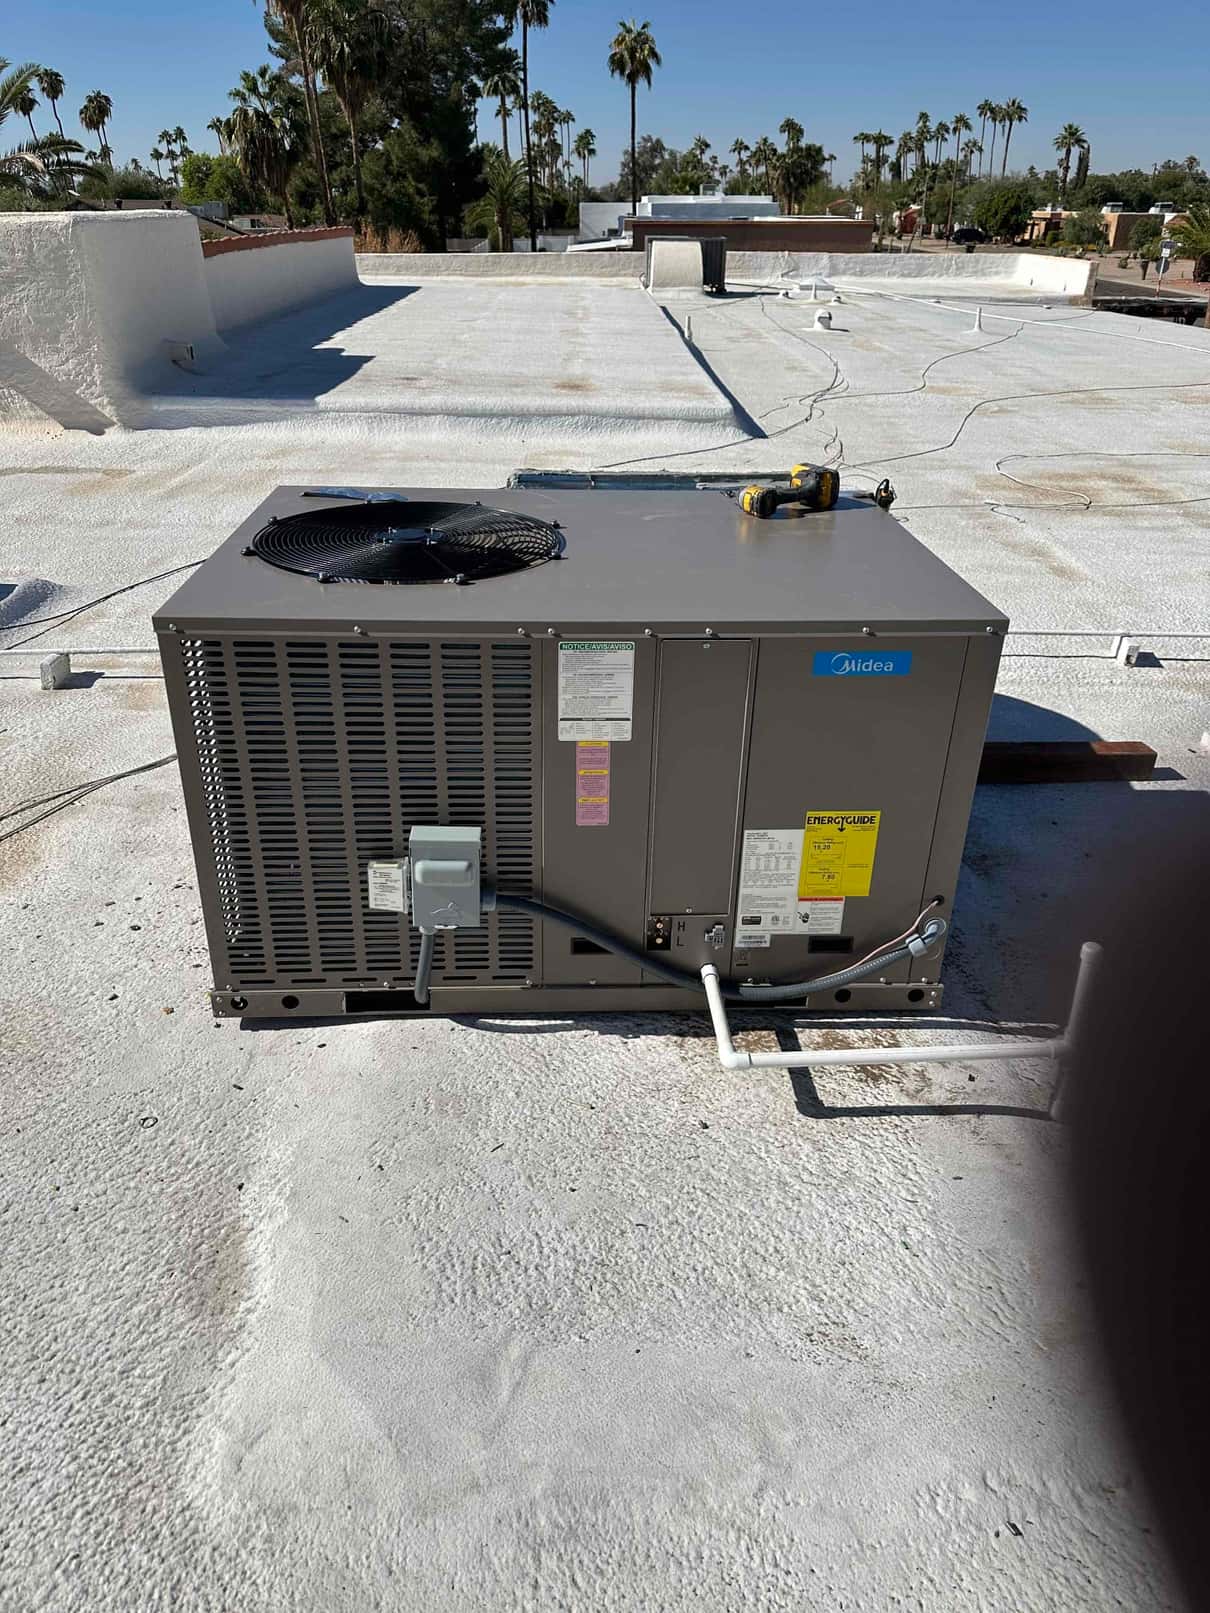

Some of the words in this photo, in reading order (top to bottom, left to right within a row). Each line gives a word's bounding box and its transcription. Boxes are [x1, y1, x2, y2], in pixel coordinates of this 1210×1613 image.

[831, 652, 894, 675] Midea
[807, 815, 876, 829] ENERGYGUIDE
[677, 920, 686, 932] H
[676, 936, 685, 947] L
